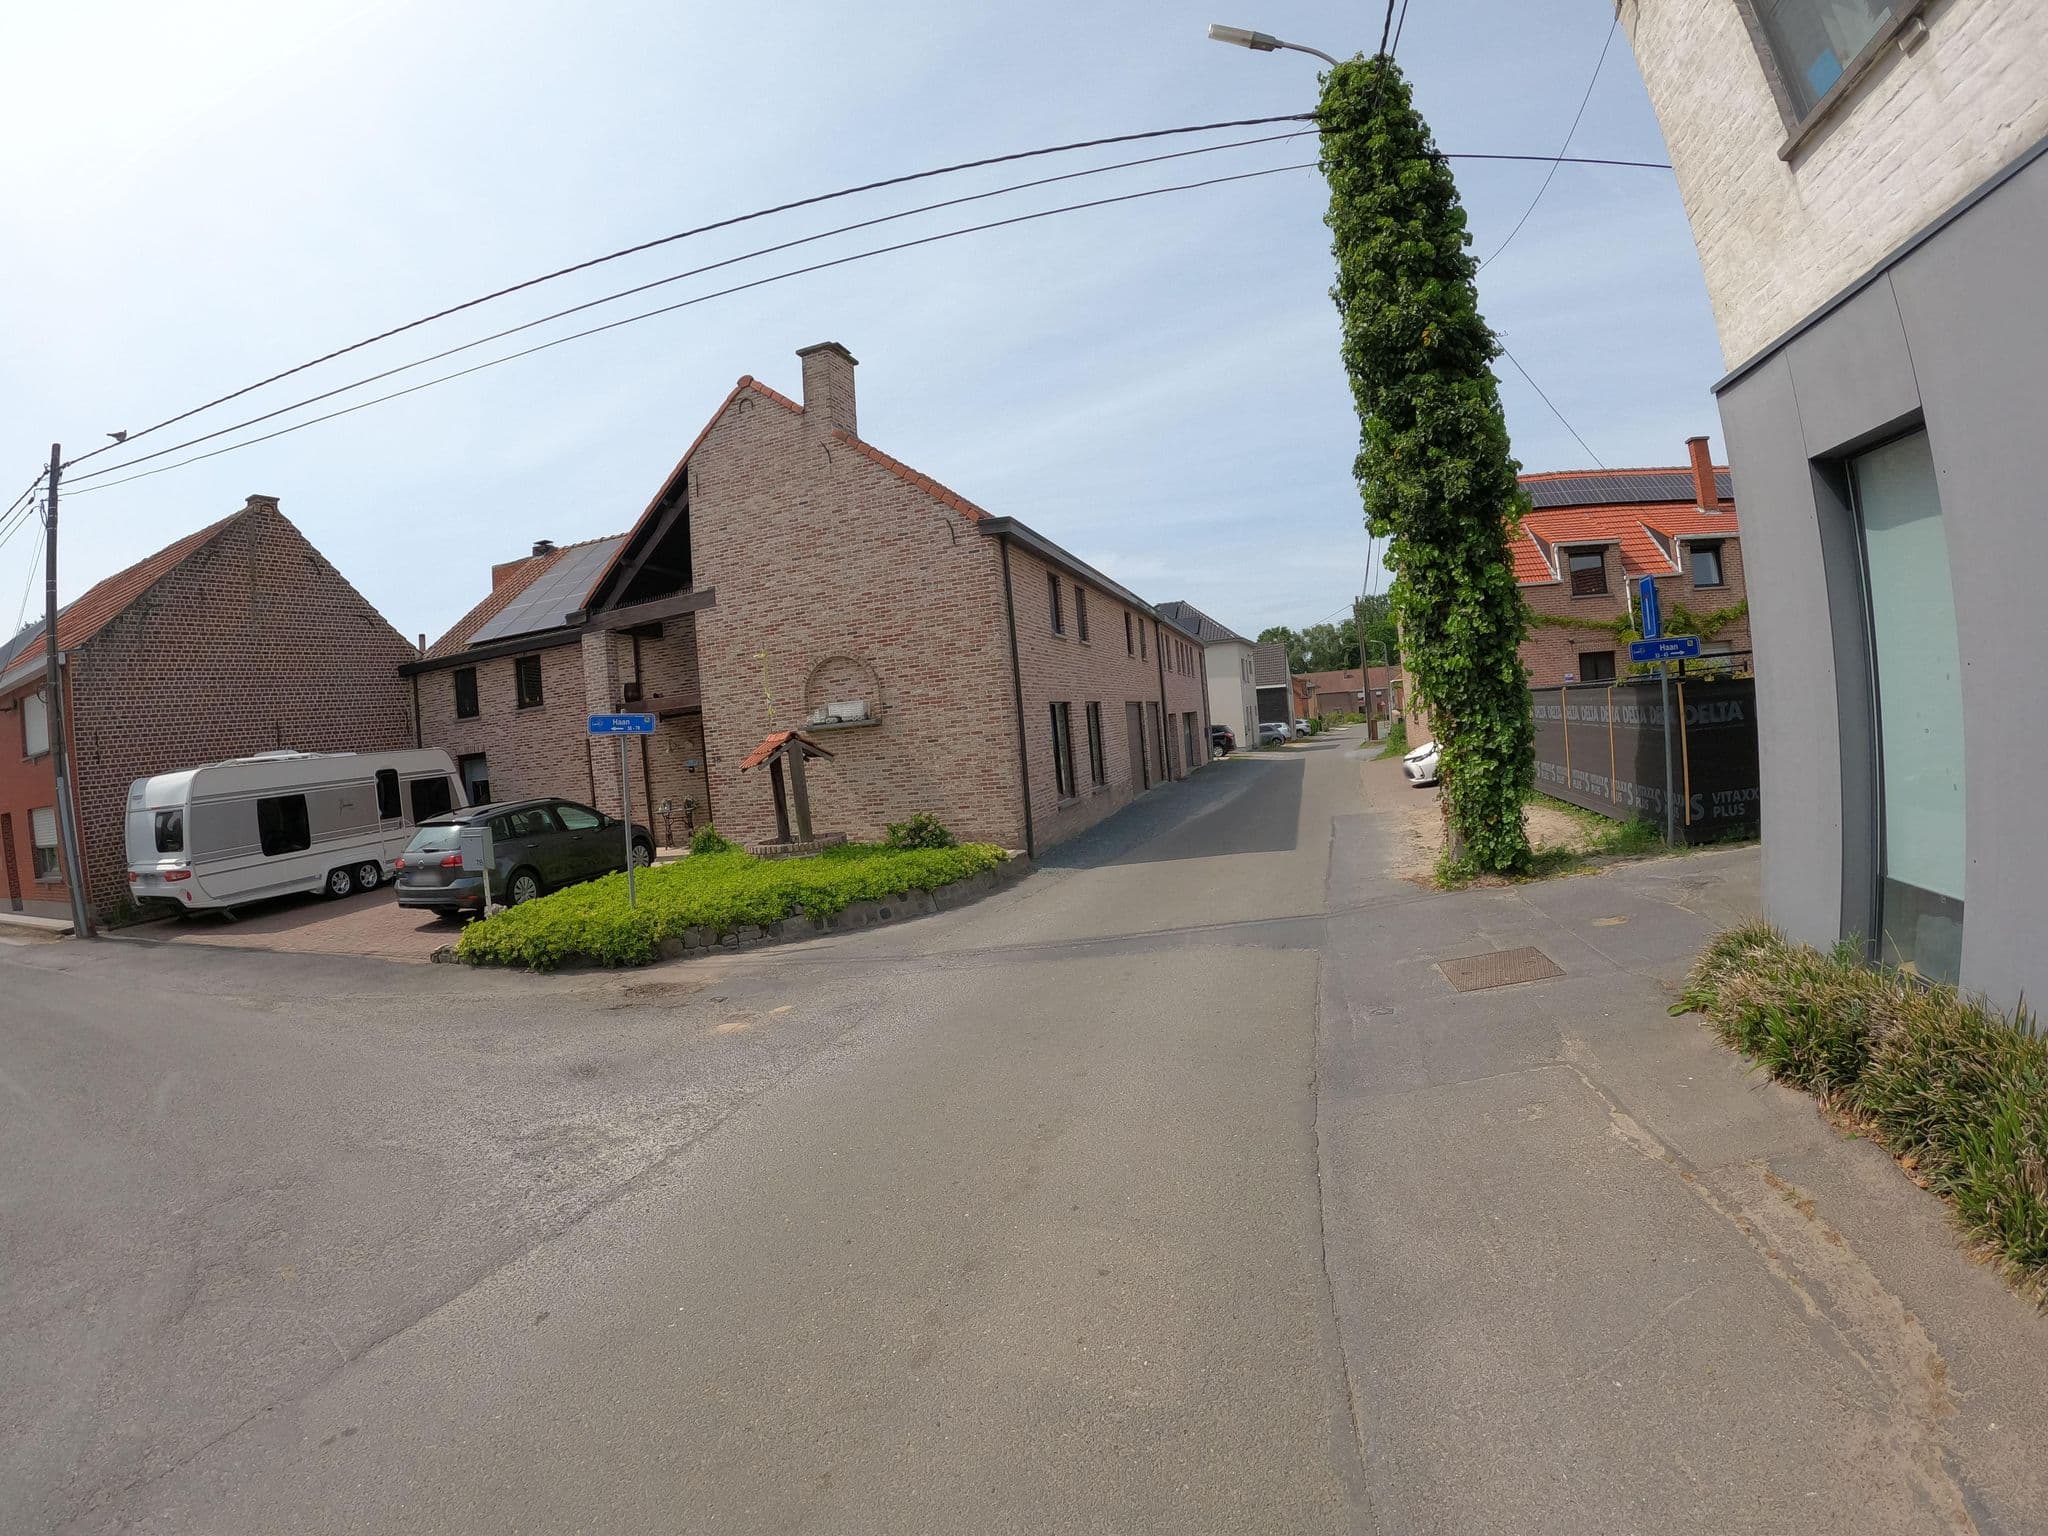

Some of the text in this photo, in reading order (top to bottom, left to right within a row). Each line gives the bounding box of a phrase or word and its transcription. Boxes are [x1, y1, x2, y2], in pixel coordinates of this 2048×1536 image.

[1660, 643, 1679, 651] Haan
[1686, 700, 1745, 726] DELTA
[612, 718, 630, 726] Haan
[1712, 787, 1760, 804] VITAXX
[1712, 803, 1746, 818] PLUS
